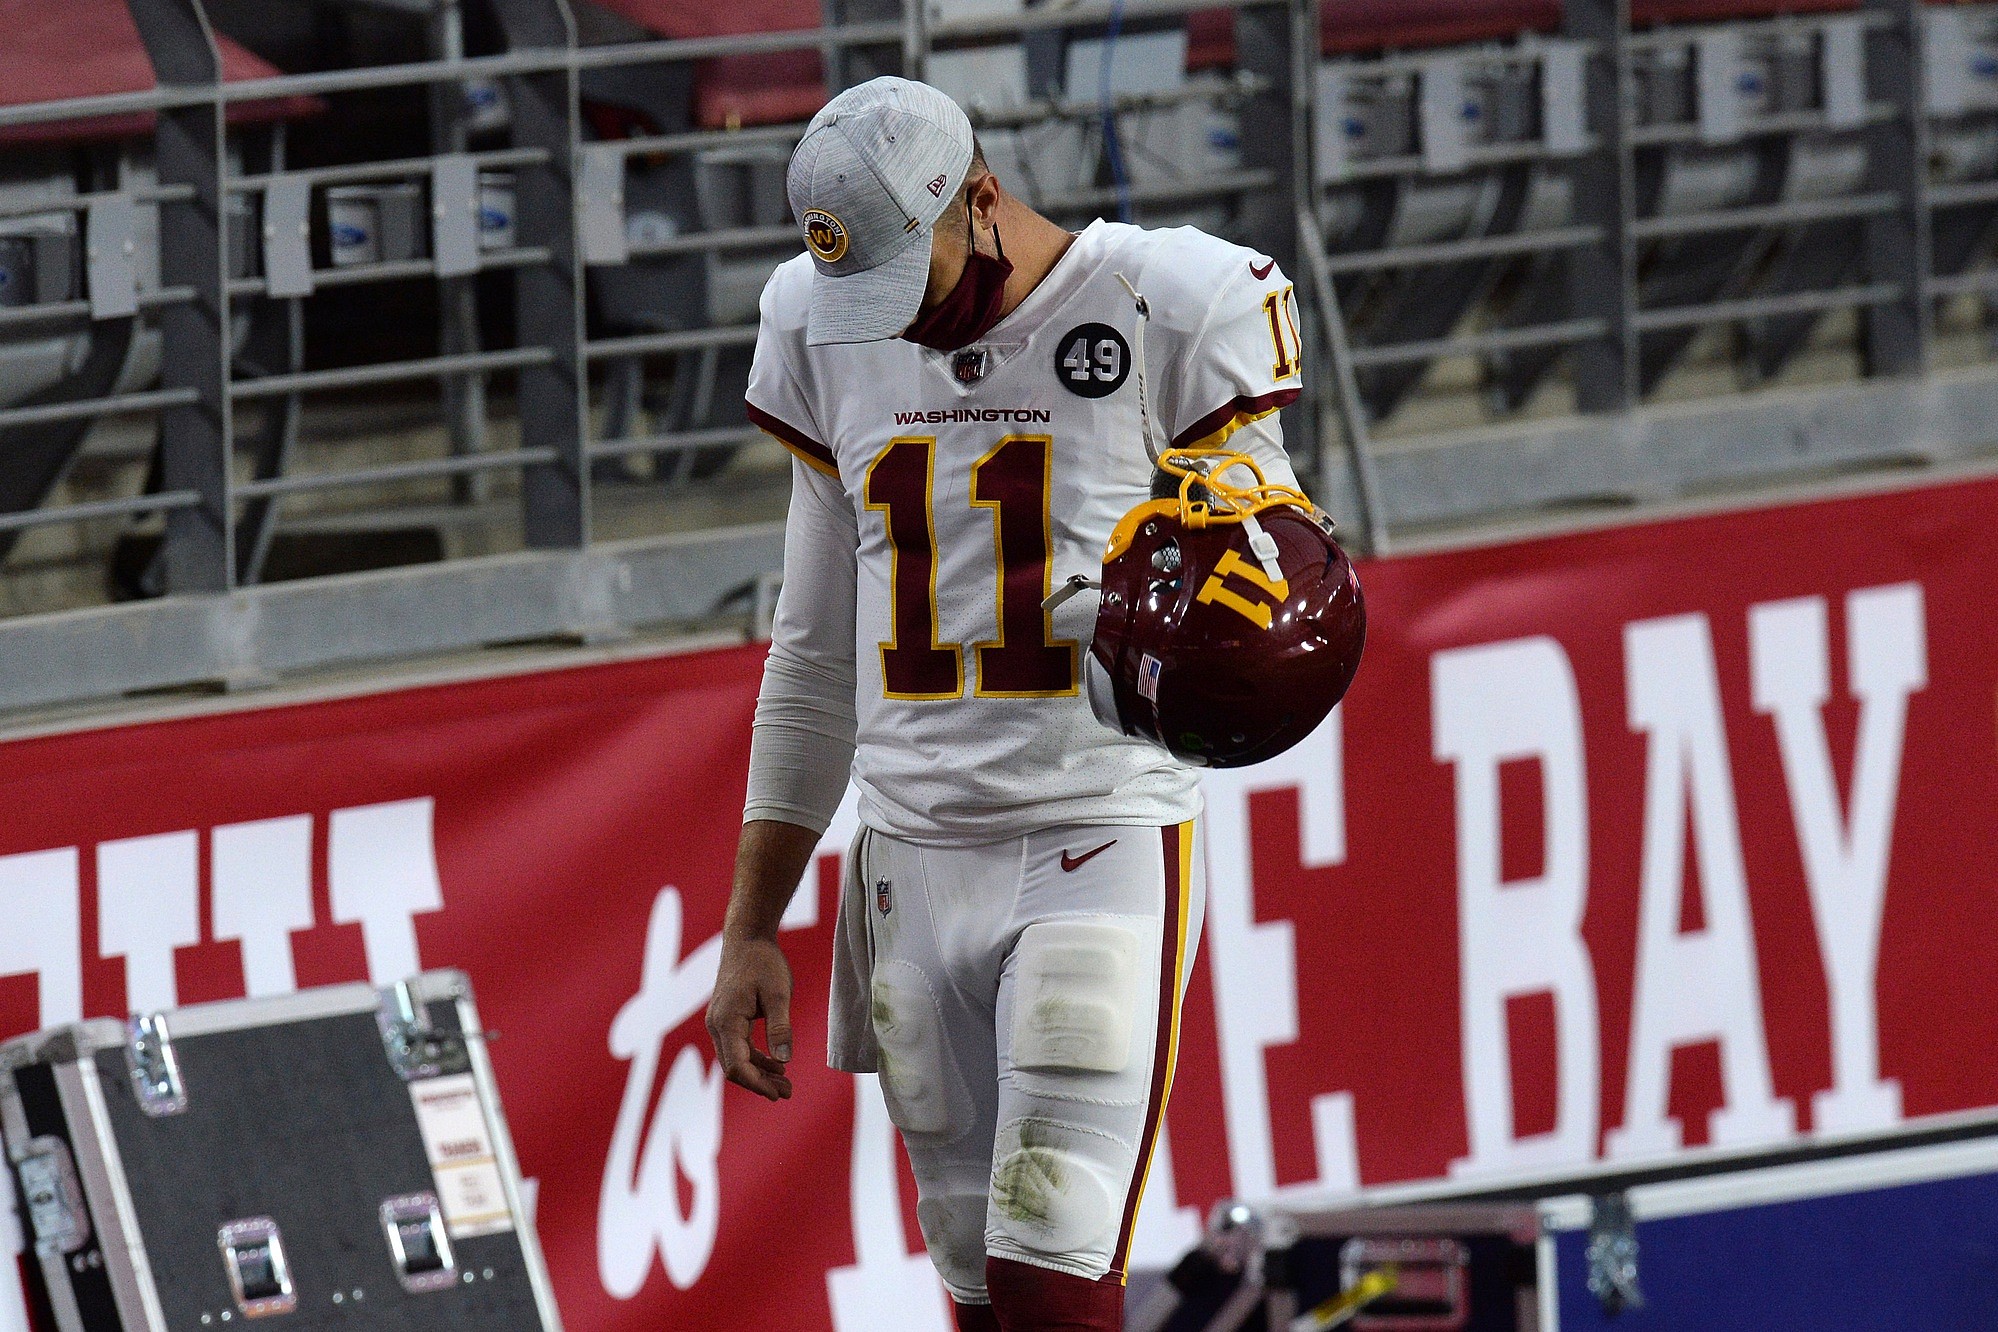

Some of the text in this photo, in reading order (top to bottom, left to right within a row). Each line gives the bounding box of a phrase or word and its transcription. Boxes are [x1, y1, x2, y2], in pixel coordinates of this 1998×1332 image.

[810, 229, 834, 245] W
[1063, 338, 1121, 382] 49
[893, 408, 1051, 426] WASHINGTON
[863, 433, 1080, 700] 11
[597, 884, 726, 1300] to
[1429, 581, 1930, 1184] BAY
